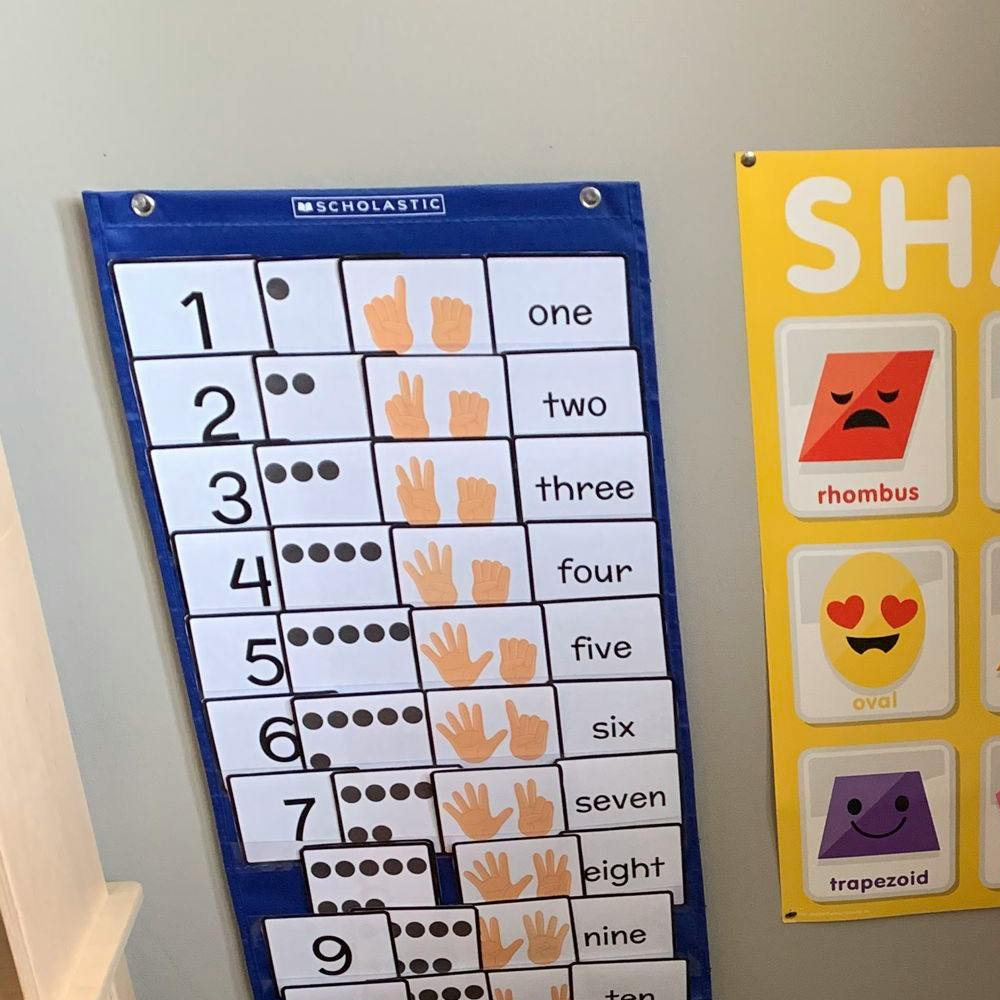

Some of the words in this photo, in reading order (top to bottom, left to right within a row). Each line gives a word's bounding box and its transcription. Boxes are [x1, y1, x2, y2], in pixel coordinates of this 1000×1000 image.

[317, 199, 440, 213] SCHOLASTIC
[180, 291, 213, 350] 1
[528, 302, 593, 326] one
[193, 385, 240, 442] 2
[542, 391, 607, 418] two
[208, 471, 252, 525] 3
[535, 474, 634, 501] three
[817, 482, 920, 506] rhombus
[229, 556, 272, 607] 4
[557, 558, 633, 585] four
[245, 638, 285, 686] 5
[571, 636, 633, 662] five
[853, 690, 898, 710] oval
[258, 716, 301, 763] 6
[592, 715, 636, 739] six
[574, 789, 667, 814] seven
[283, 798, 316, 842] 7
[582, 857, 666, 886] eight
[829, 869, 929, 895] trapezoid
[583, 925, 647, 946] nine
[312, 935, 353, 976] 9
